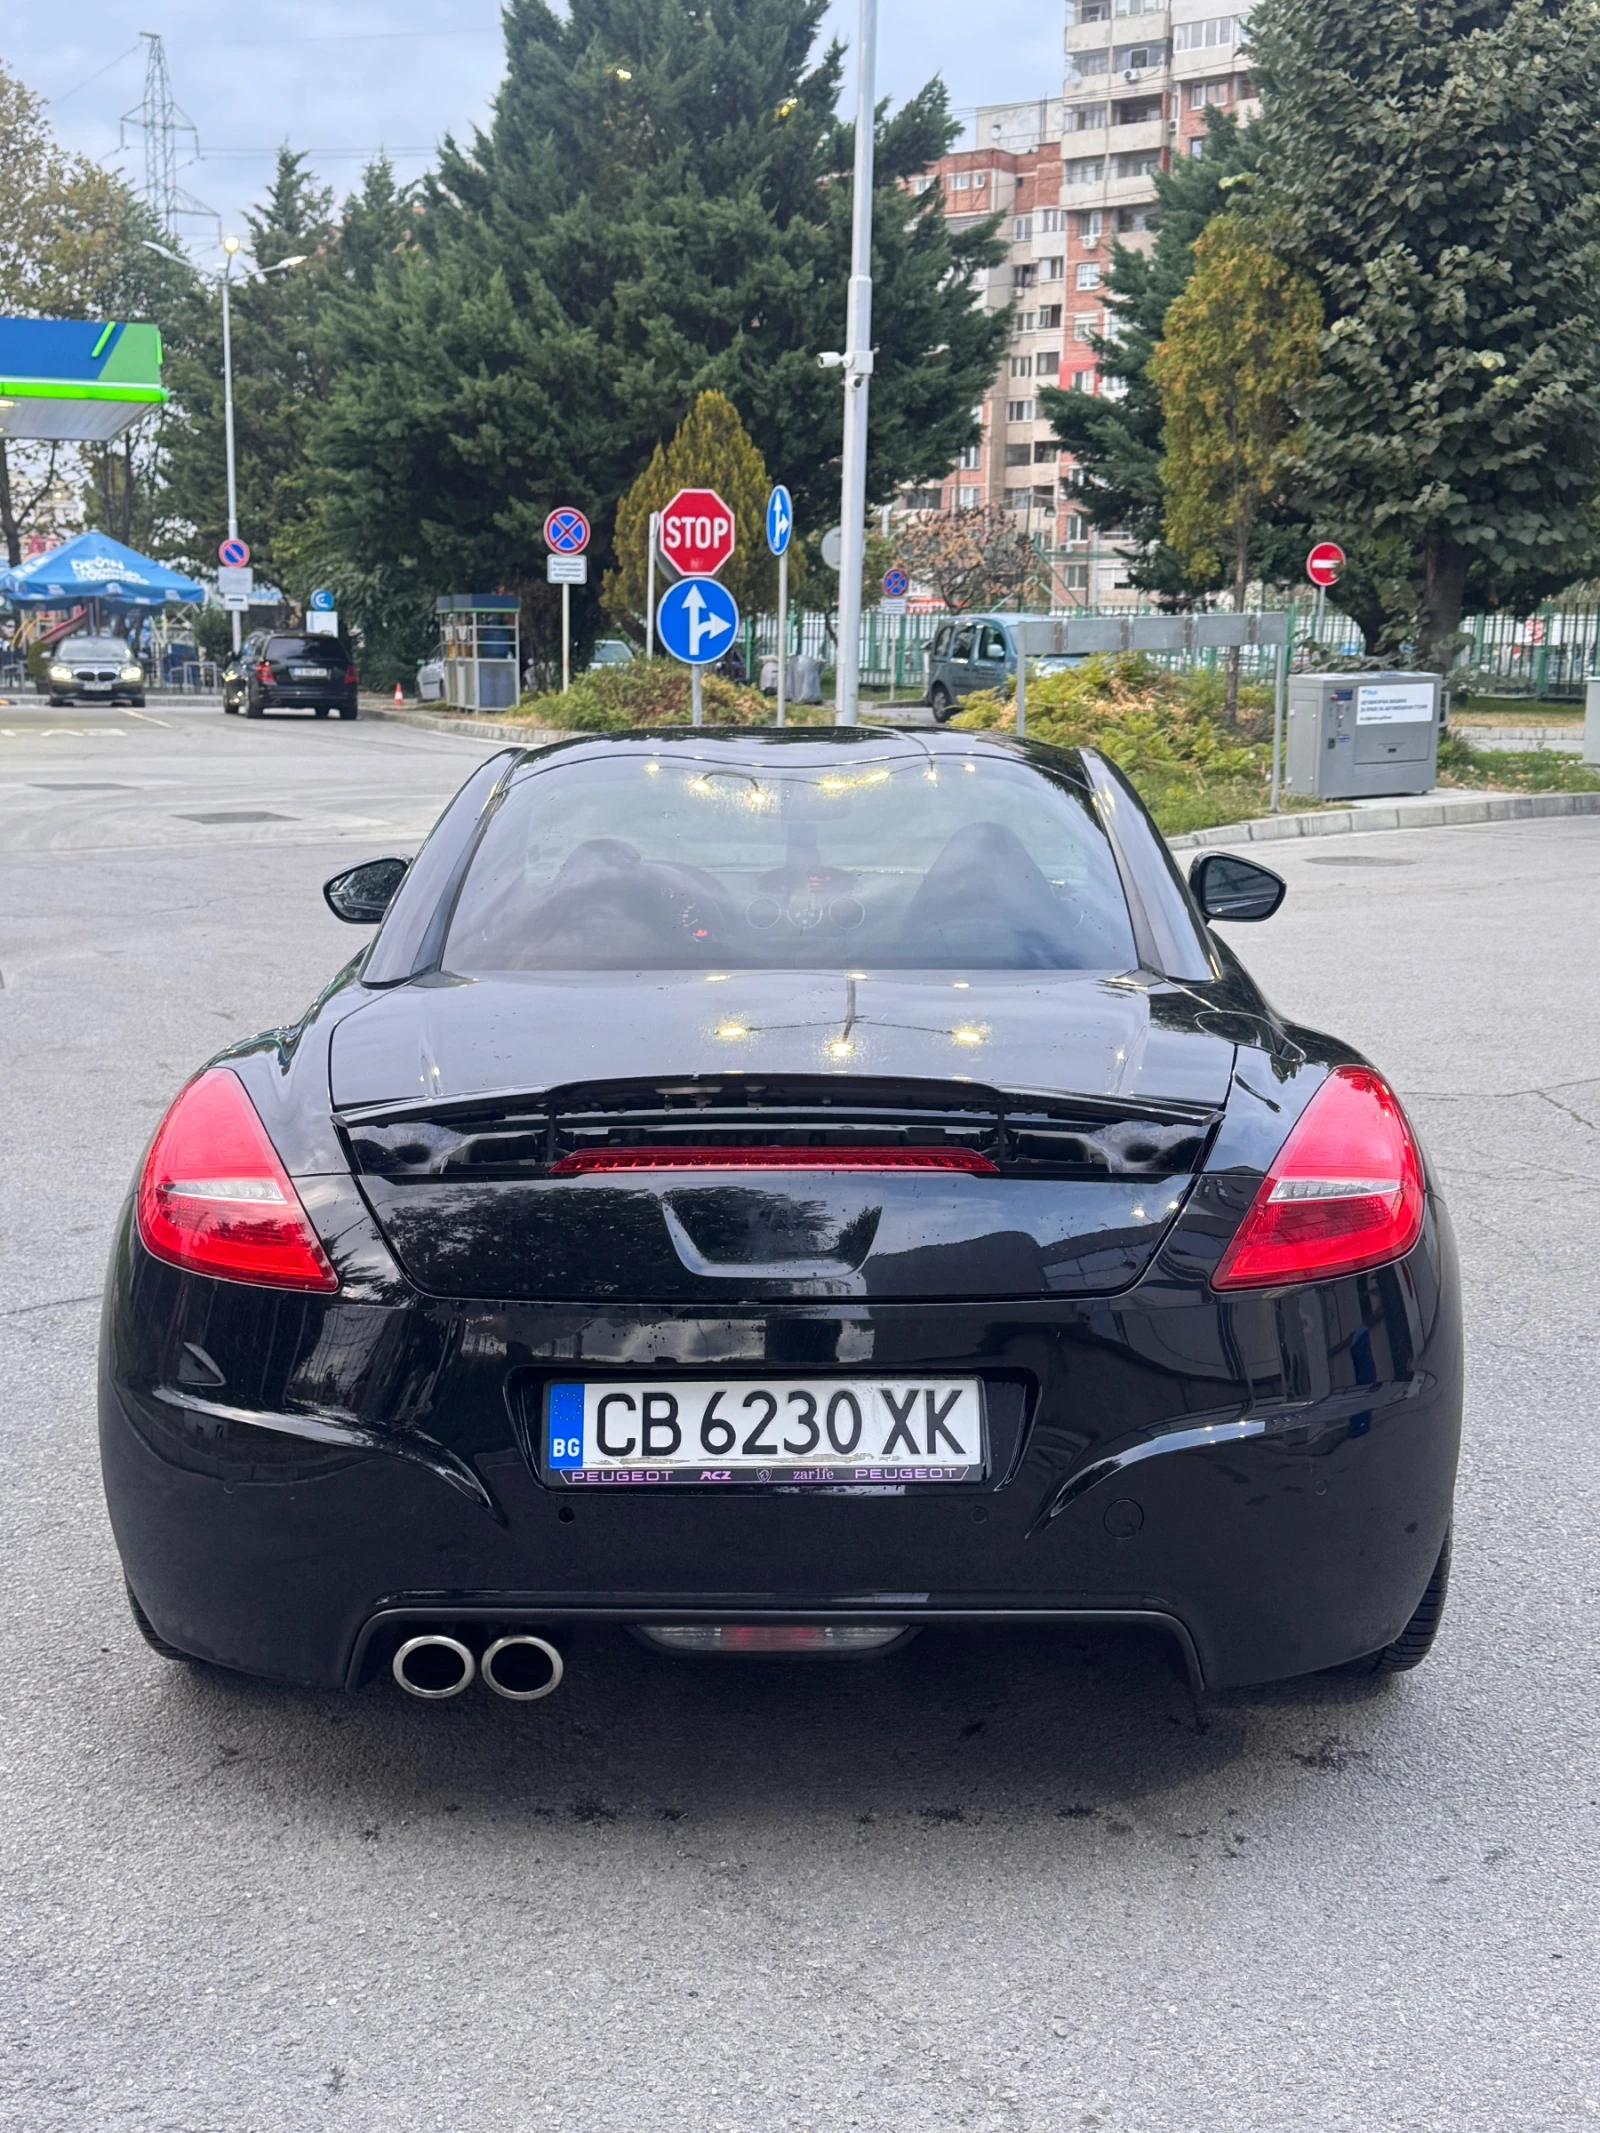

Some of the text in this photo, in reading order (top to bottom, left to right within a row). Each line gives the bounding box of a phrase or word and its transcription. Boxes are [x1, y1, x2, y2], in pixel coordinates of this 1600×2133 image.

[665, 515, 729, 549] STOP
[595, 1388, 967, 1457] CB 6230 XK
[552, 1438, 580, 1458] BG
[571, 1470, 674, 1482] PEUGEOT
[699, 1470, 732, 1481] RCZ
[854, 1467, 958, 1479] PEUGEOT
